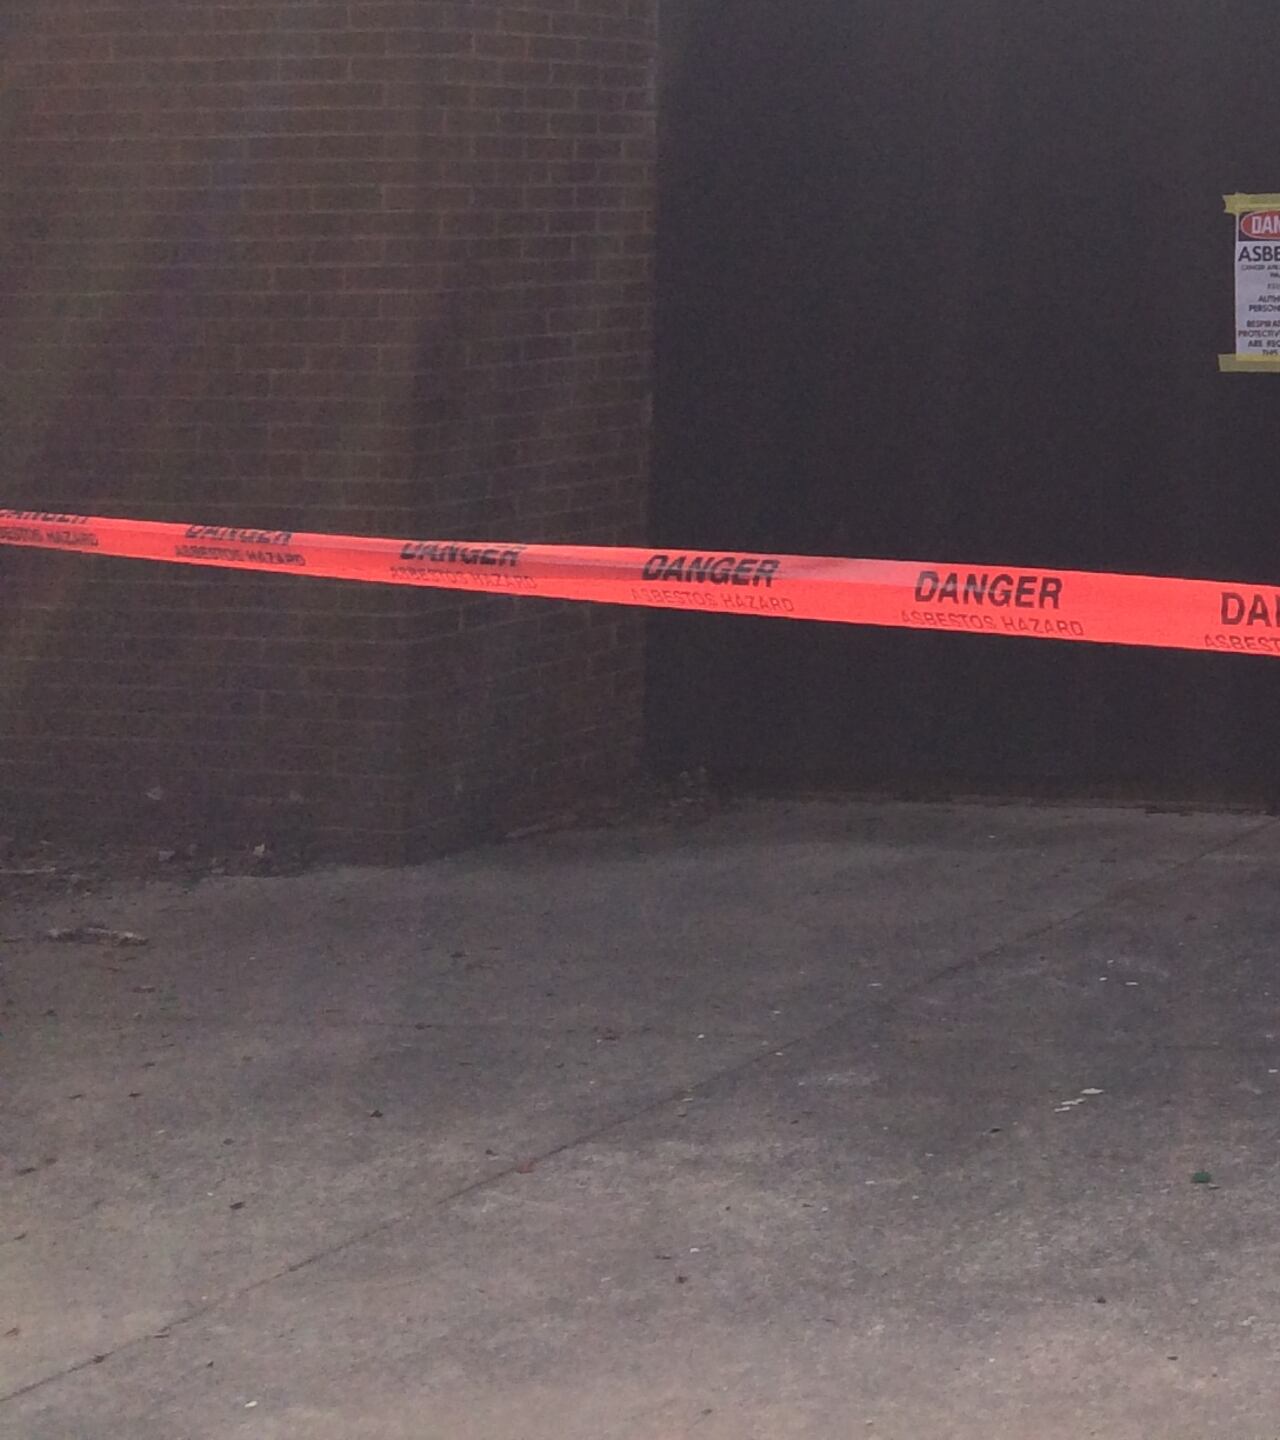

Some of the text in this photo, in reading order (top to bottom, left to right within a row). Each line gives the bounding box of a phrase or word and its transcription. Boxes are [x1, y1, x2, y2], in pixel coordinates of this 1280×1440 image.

[400, 542, 527, 568] DANGER
[642, 554, 781, 589] DANGER
[632, 587, 795, 613] ASBESTOS HAZARD
[914, 570, 1064, 610] DANGER
[901, 609, 1085, 637] ASBESTOS HAZARD
